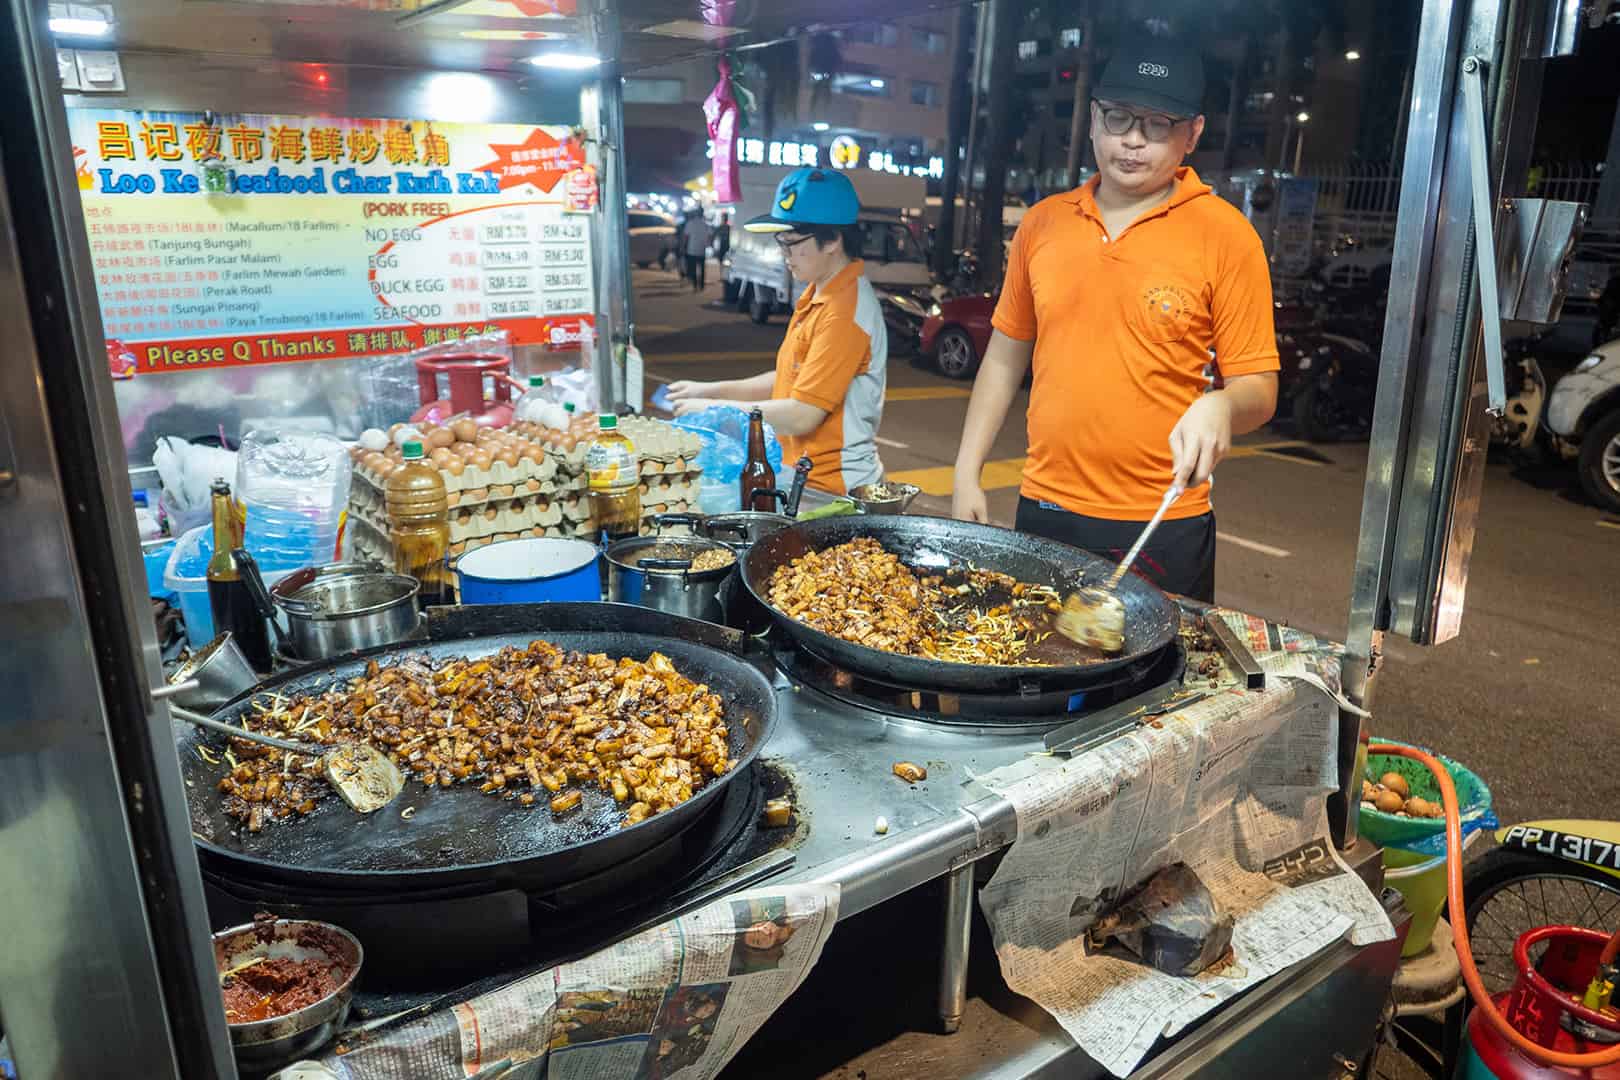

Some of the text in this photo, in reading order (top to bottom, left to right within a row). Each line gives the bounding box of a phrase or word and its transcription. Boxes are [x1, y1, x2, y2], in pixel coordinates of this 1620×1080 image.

[97, 168, 155, 194] Loo
[332, 167, 391, 194] Char
[456, 170, 500, 194] Kak
[363, 202, 450, 219] (PORK FREE)
[365, 228, 388, 242] NO
[391, 227, 422, 242] EGG
[543, 224, 558, 238] RM
[148, 239, 200, 251] (Tanjung
[204, 238, 251, 251] Bungah)
[164, 255, 204, 266] (Farlim
[207, 254, 237, 265] Pasar
[240, 253, 281, 264] Malam)
[367, 254, 398, 269] EGG
[222, 269, 260, 281] (Farlim
[202, 286, 237, 297] (Perak
[241, 284, 272, 296] Road)
[370, 279, 411, 294] DUCK
[415, 277, 445, 292] EGG
[488, 276, 505, 289] RM
[172, 303, 214, 316] (Sungai
[218, 301, 260, 313] Pinang)
[373, 304, 441, 321] SEAFOOD
[491, 301, 507, 313] RM
[147, 347, 224, 367] Please
[232, 341, 251, 361] Q
[257, 336, 336, 355] Thanks
[1505, 826, 1558, 854] PPJ
[1266, 846, 1325, 878] BYD
